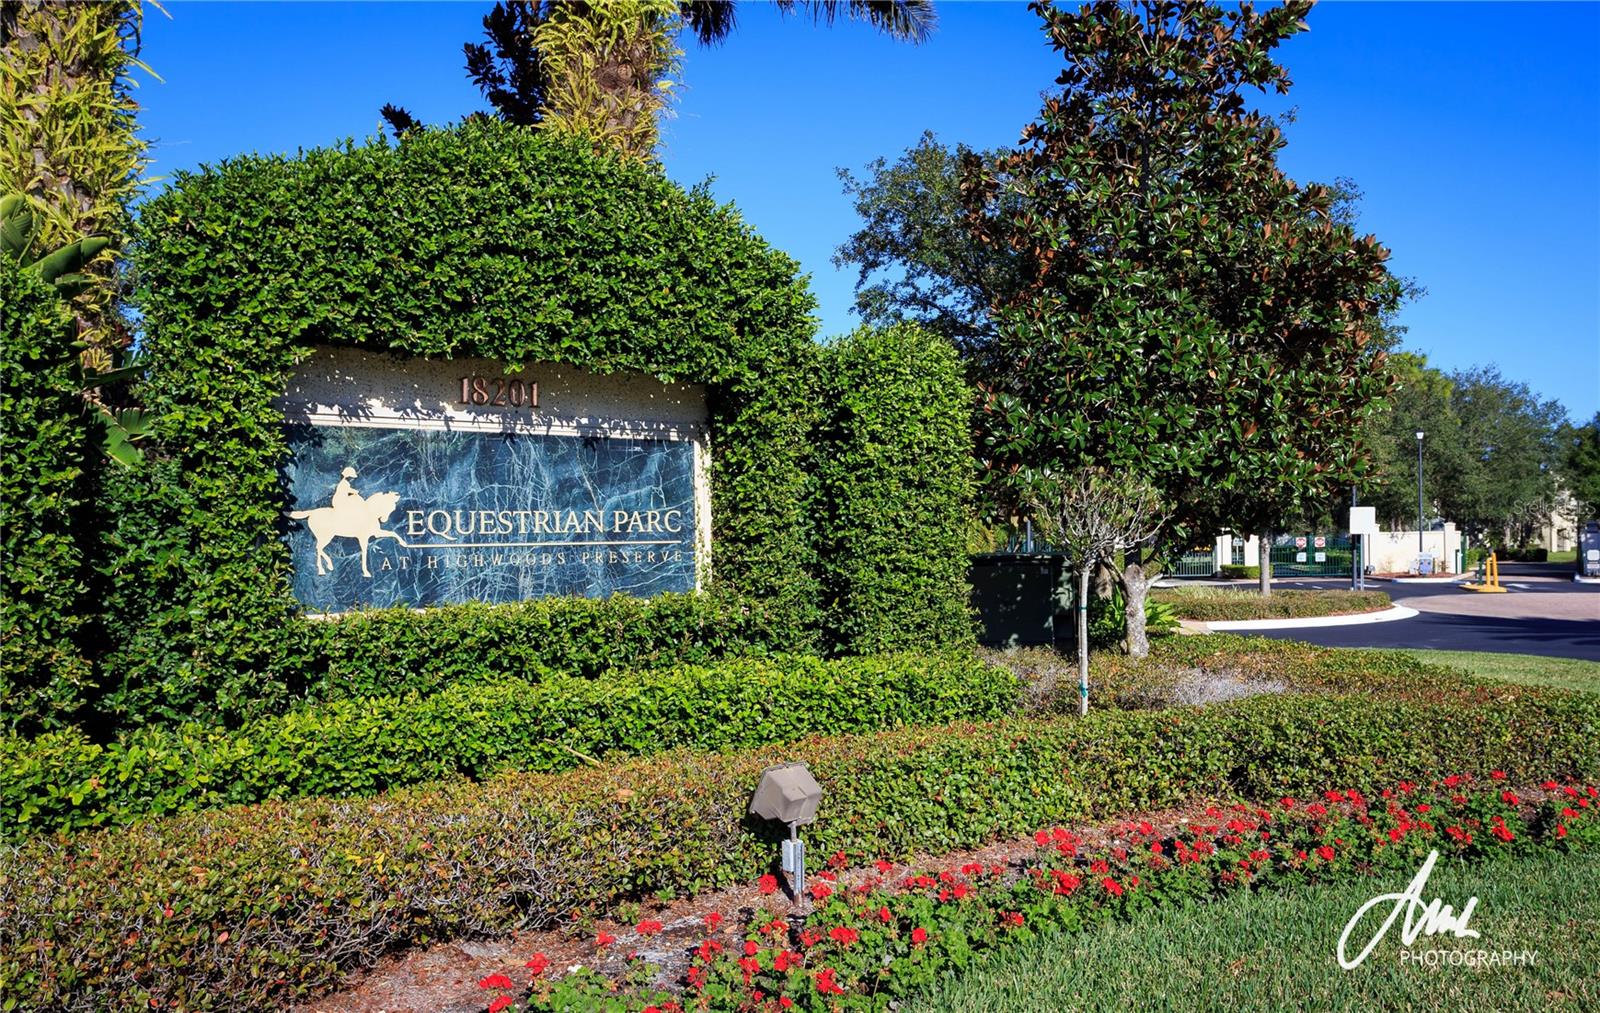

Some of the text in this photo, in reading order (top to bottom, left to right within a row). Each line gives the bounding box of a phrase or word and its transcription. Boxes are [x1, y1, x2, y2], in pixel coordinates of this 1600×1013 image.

[458, 376, 540, 409] 18201
[407, 509, 682, 541] EQUESTRIAN PARC
[381, 550, 683, 571] AT HIGHWOODS PRESERVE
